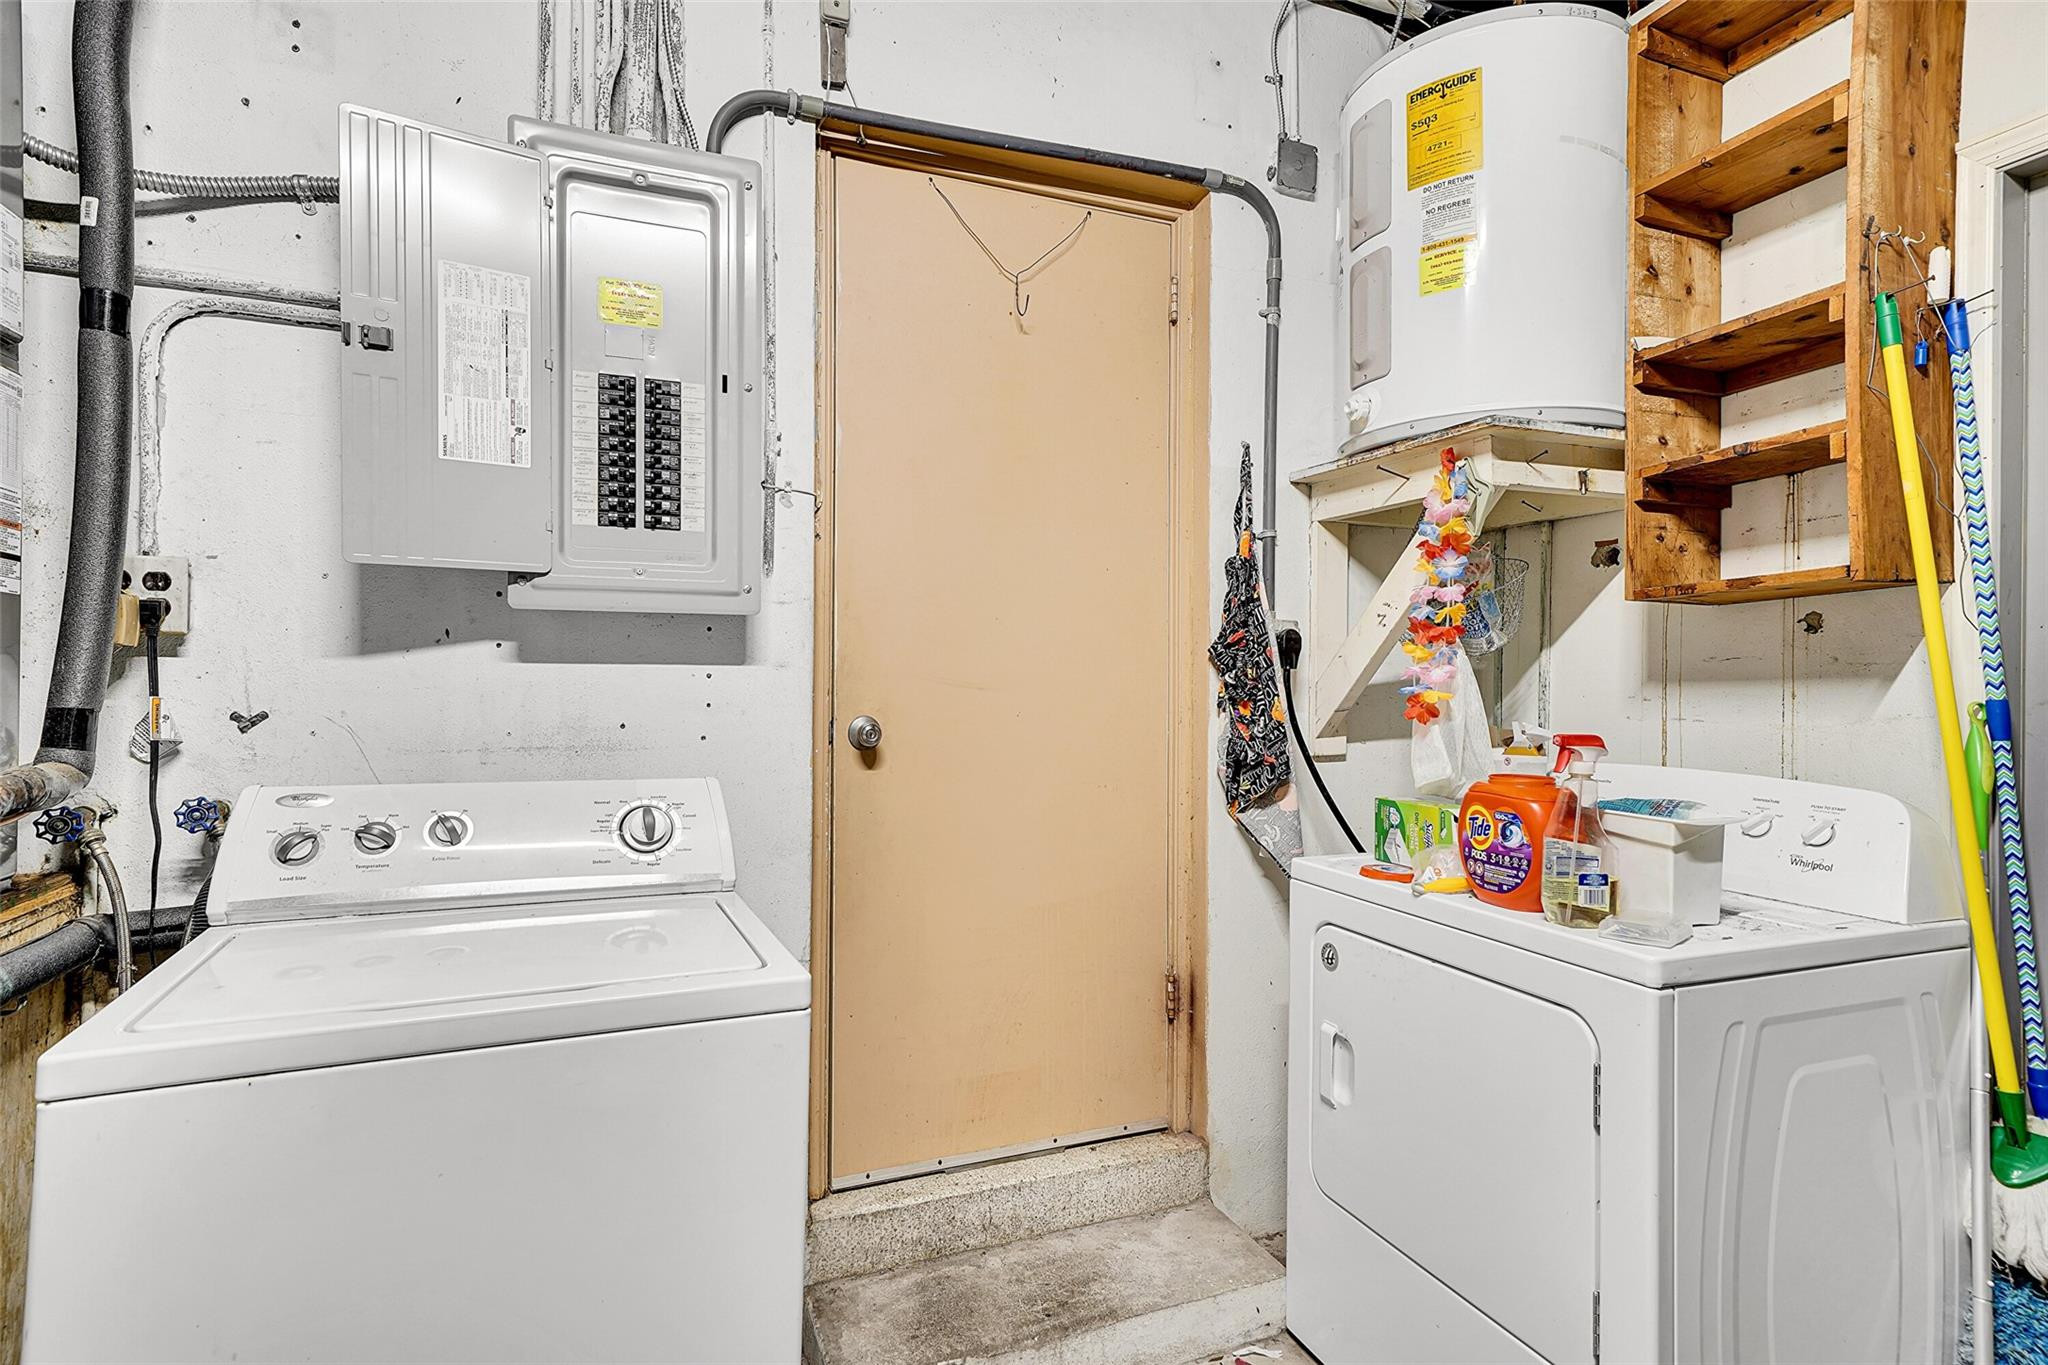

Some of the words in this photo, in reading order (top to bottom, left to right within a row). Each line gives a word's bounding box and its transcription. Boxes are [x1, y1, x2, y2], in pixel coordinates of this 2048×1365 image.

[1410, 72, 1477, 104] ENERGYGUIDE
[1411, 113, 1438, 130] $503
[1427, 140, 1447, 152] 4721
[1423, 186, 1432, 194] DO
[1433, 181, 1446, 190] NOT
[1447, 174, 1474, 186] RETURN
[1425, 207, 1436, 216] NO
[1437, 198, 1472, 212] REGRESE
[1468, 816, 1491, 839] Tide
[1471, 849, 1487, 861] PODS
[1790, 857, 1834, 873] Whirlpool
